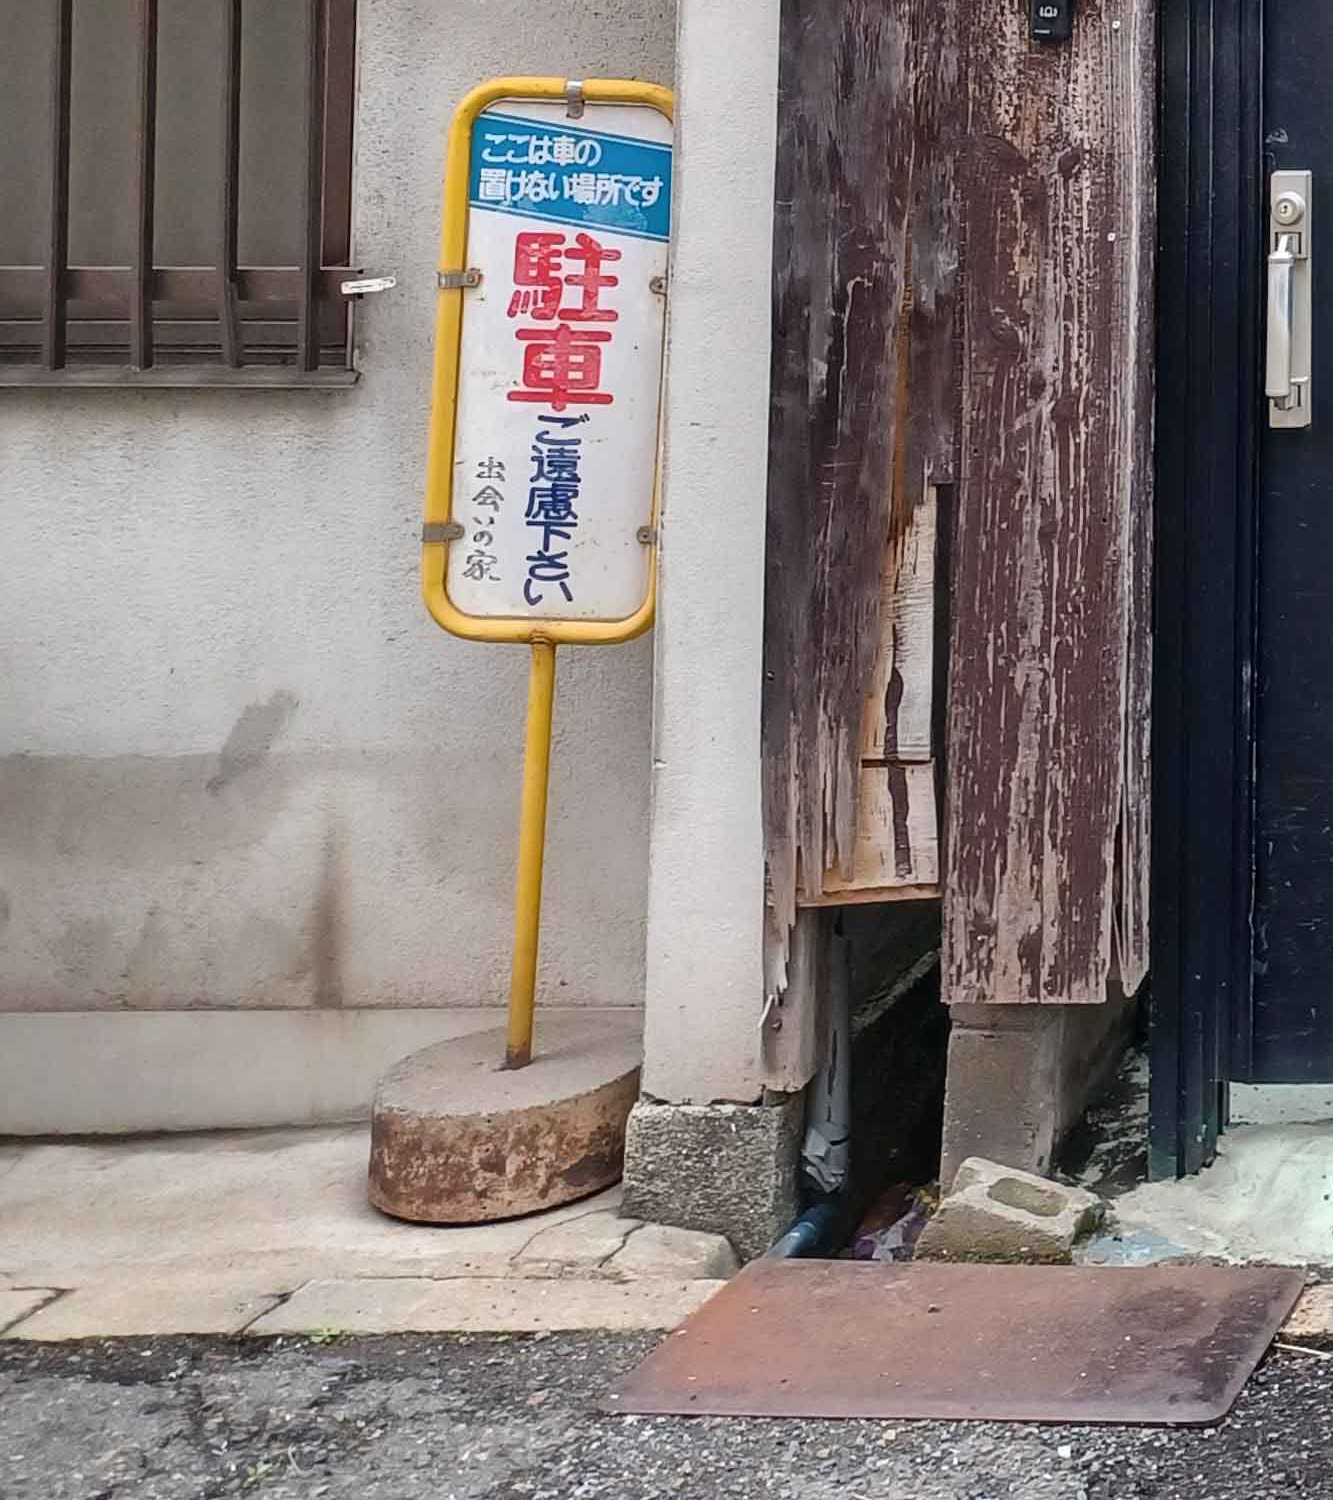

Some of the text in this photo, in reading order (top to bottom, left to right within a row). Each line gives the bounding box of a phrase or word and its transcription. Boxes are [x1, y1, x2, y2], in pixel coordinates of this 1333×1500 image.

[477, 168, 664, 209] 置けない場所です
[480, 132, 602, 167] ここは車の
[505, 231, 622, 607] 駐車 ご遠慮下さい
[463, 455, 505, 582] 出会いの家
